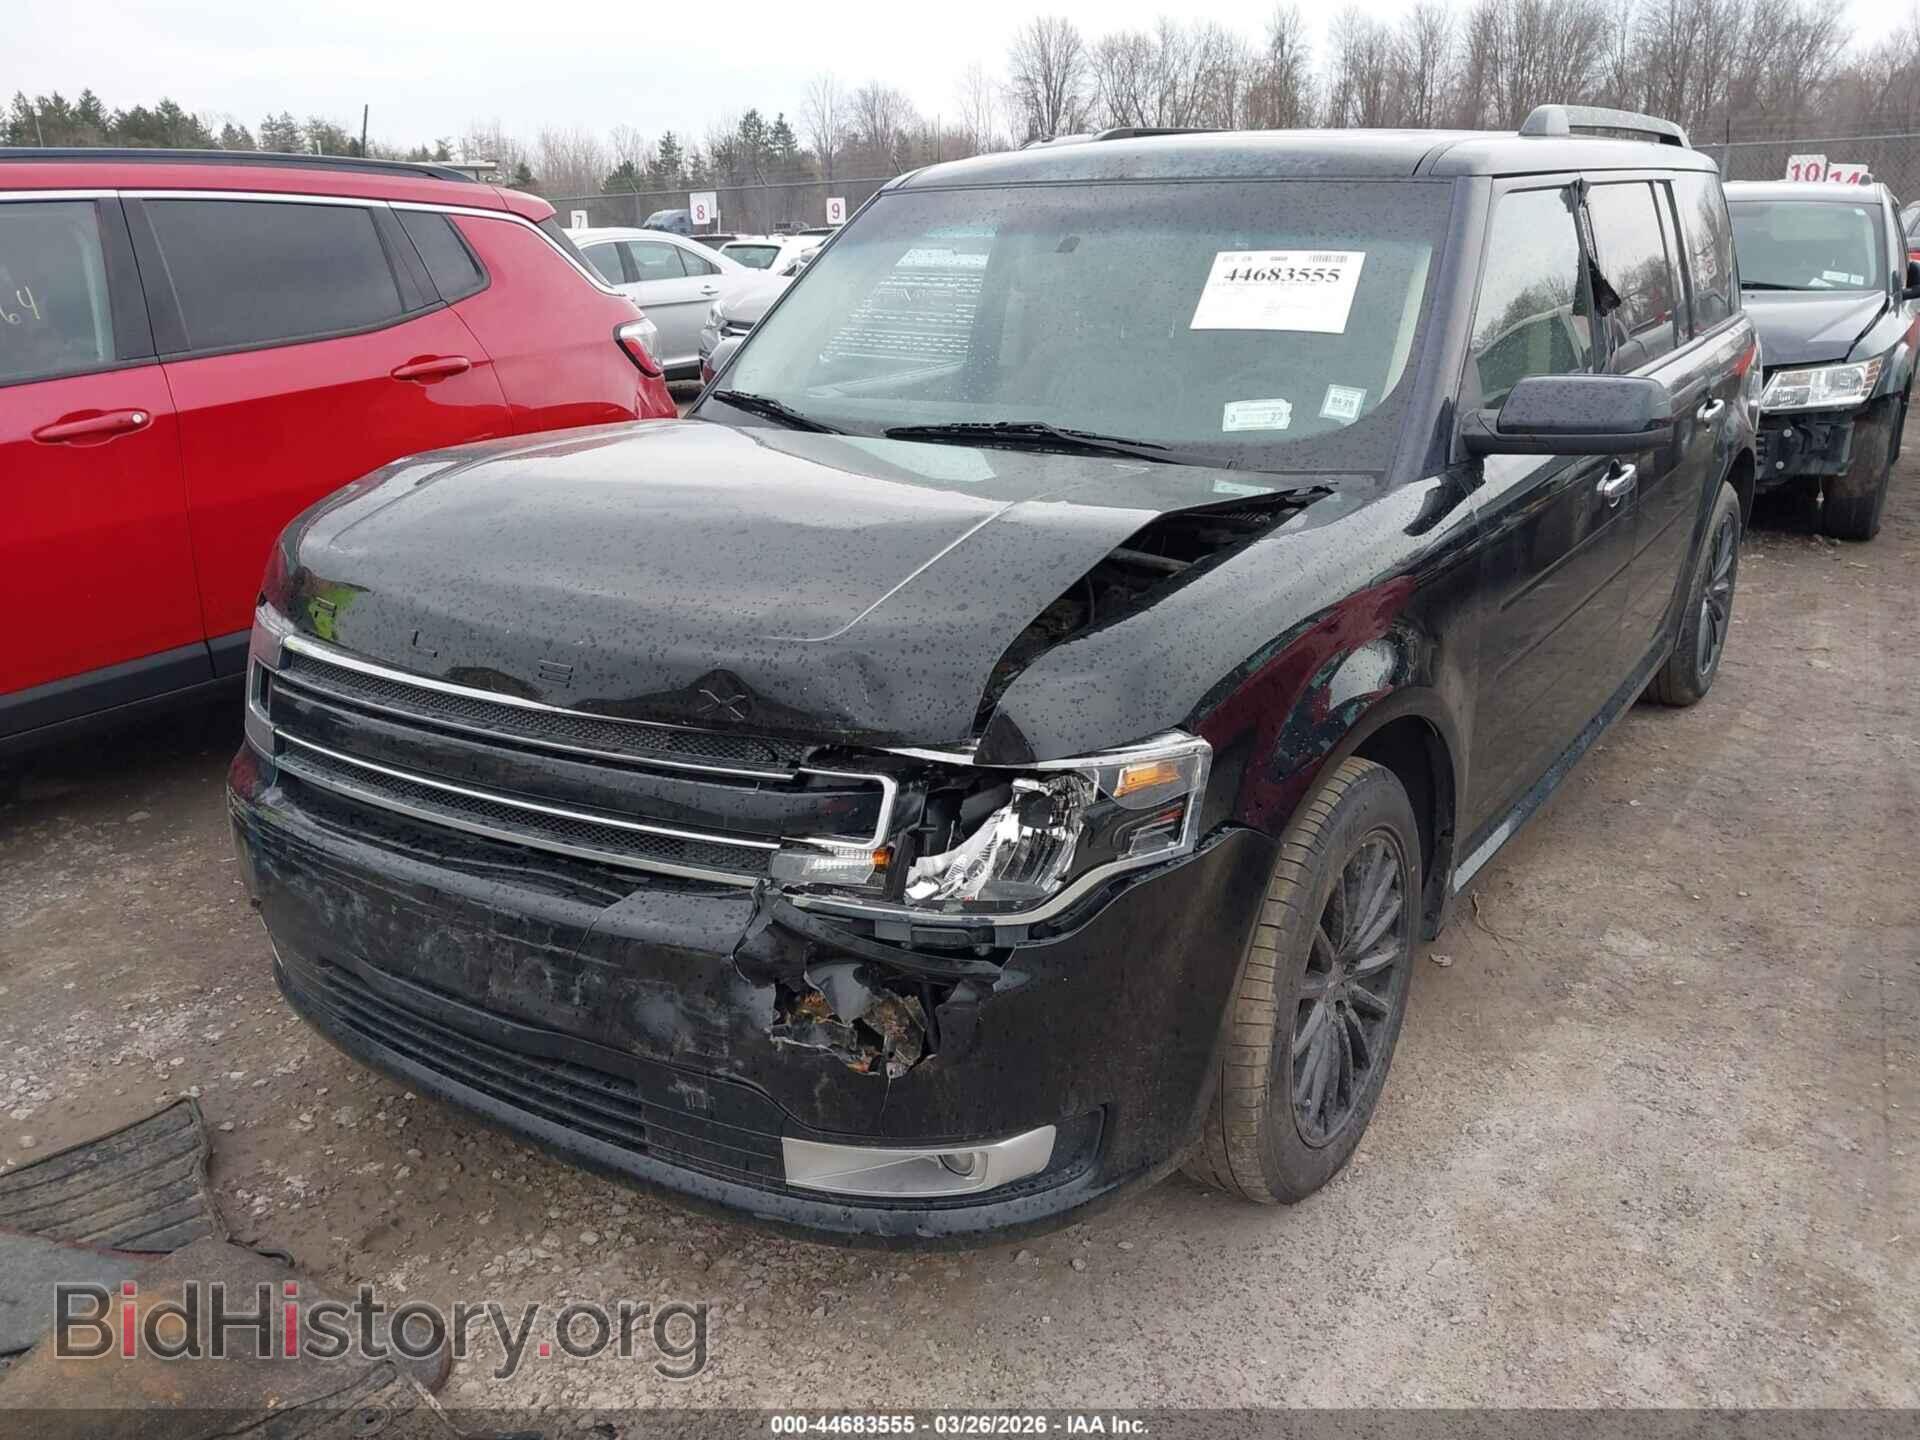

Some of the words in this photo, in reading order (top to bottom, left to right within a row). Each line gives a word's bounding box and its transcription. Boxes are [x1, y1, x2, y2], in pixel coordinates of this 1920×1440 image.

[1791, 163, 1821, 182] 10
[696, 204, 705, 220] 8
[831, 202, 841, 219] 9
[575, 214, 583, 229] 7
[1223, 267, 1342, 283] 44683555
